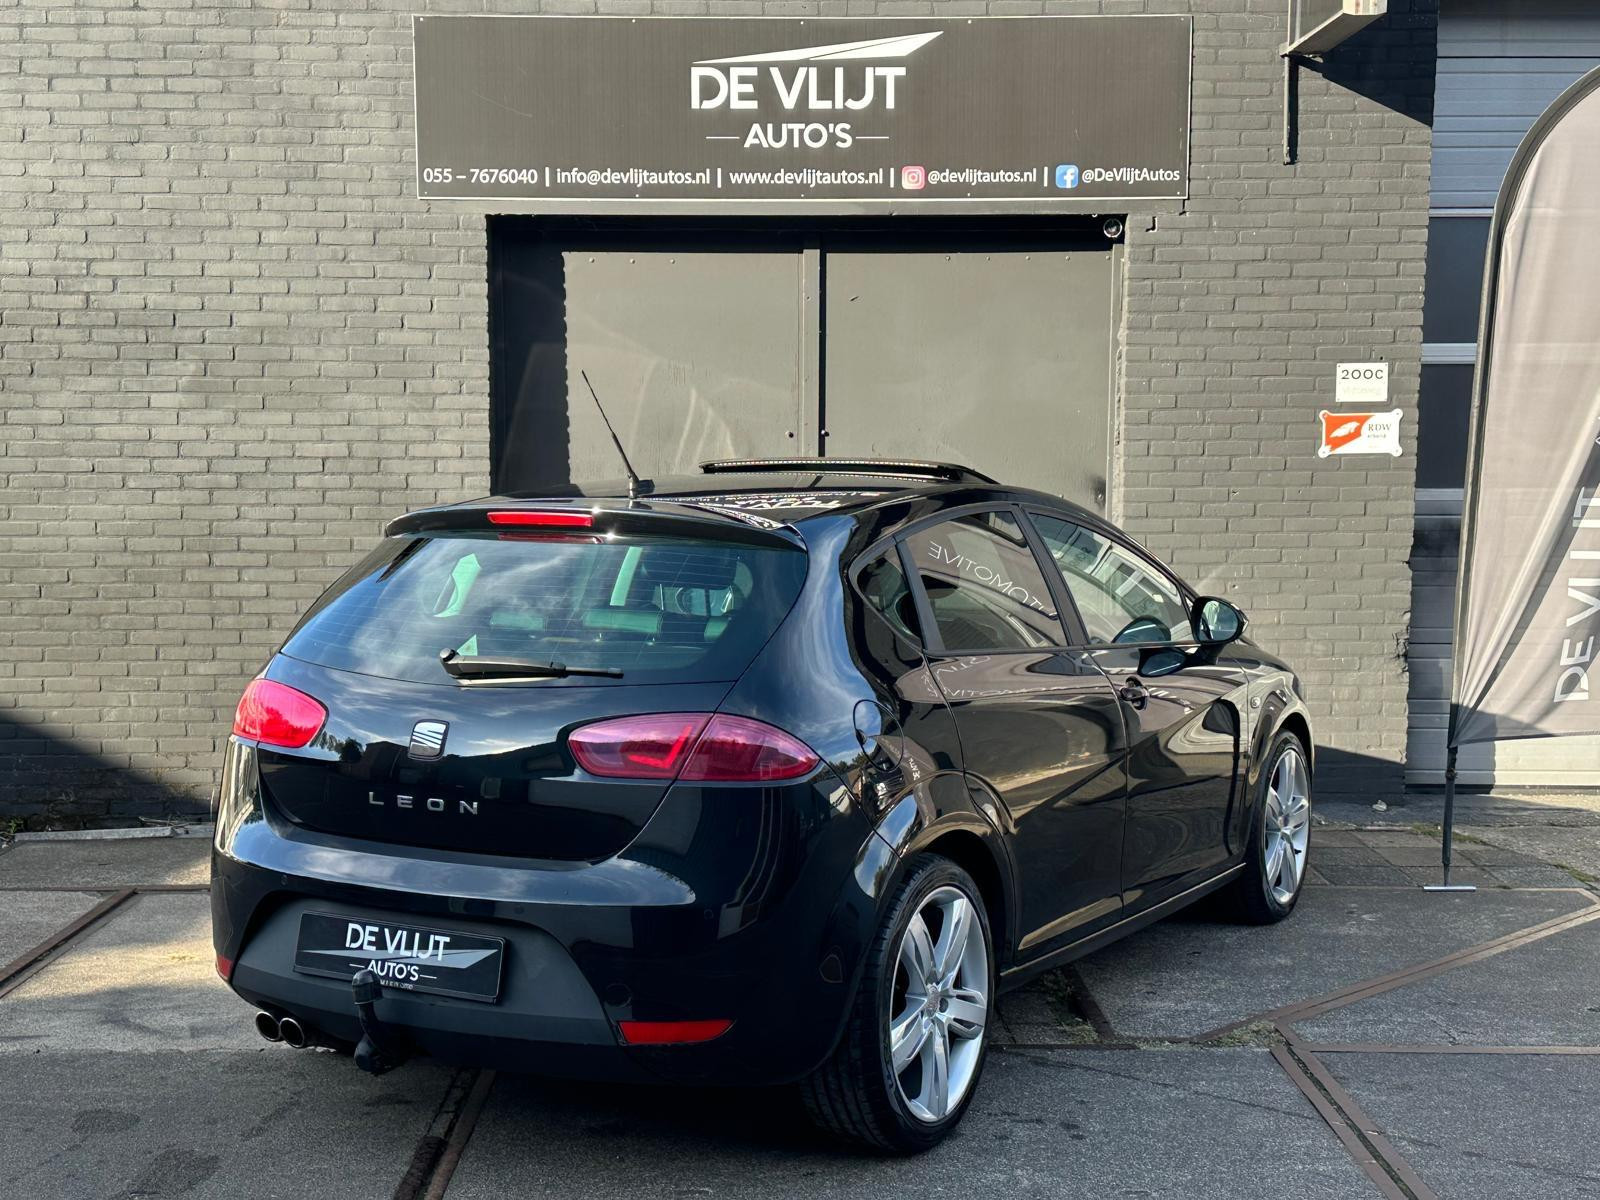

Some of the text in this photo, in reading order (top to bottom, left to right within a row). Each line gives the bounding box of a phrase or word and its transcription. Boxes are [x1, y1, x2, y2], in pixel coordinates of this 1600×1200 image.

[691, 66, 907, 110] DE VLIJT
[743, 122, 853, 149] AUTO'S
[423, 168, 453, 184] 055
[470, 168, 538, 185] 7676040
[556, 168, 711, 188] info@devlijtautos.nl
[729, 168, 883, 188] www.devlijtautos.nl
[928, 167, 1037, 187] @devlijtautos.nl
[1081, 167, 1180, 187] @DeVlijtAutos
[1341, 369, 1384, 380] 200C
[1368, 423, 1392, 432] RDW
[1554, 636, 1595, 703] DE
[368, 791, 478, 814] LEON
[345, 922, 451, 961] DE VLIJT
[366, 959, 420, 982] AUTO'S
